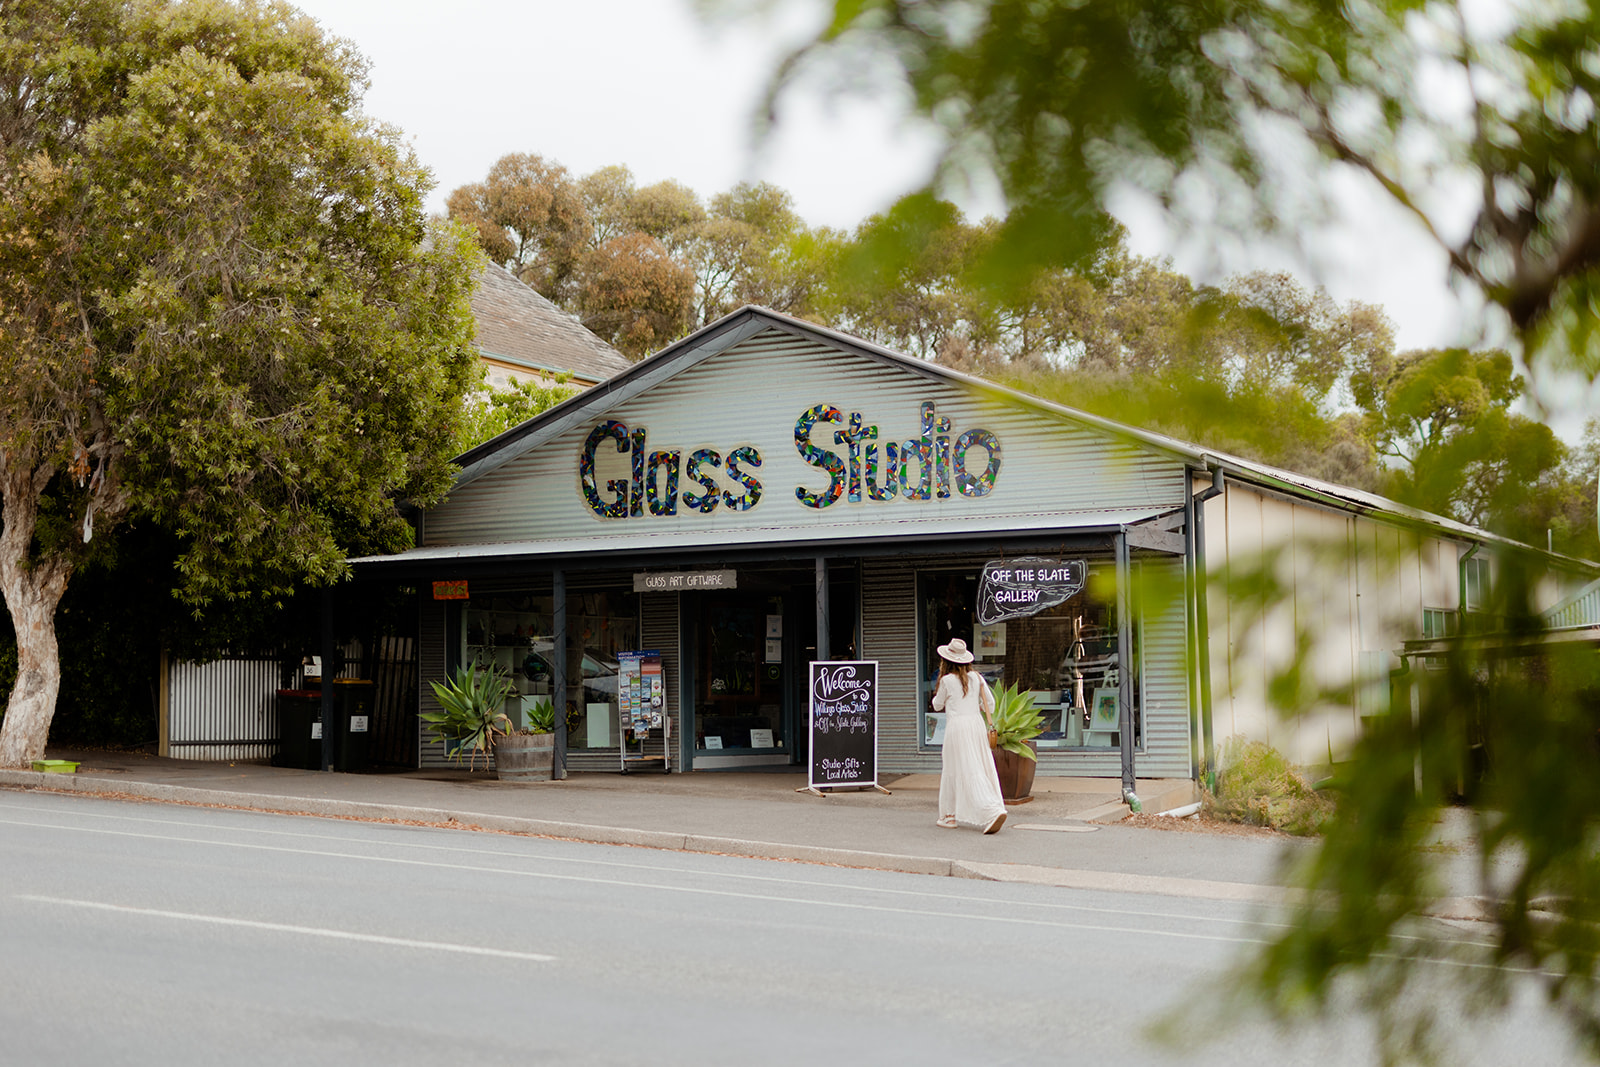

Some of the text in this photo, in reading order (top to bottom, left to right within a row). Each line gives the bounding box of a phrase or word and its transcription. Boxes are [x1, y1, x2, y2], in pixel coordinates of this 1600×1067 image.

[580, 401, 1001, 518] Glass Studio
[645, 574, 723, 588] GLASS ART GIFTWARE
[991, 568, 1071, 582] OFF THE SLATE
[995, 589, 1041, 603] GALLERY
[815, 666, 871, 699] Welcome
[836, 701, 851, 716] Glass
[851, 701, 868, 714] Studio
[819, 717, 829, 734] Off
[822, 758, 860, 769] Studio Gifts
[827, 769, 858, 780] Local Artists
